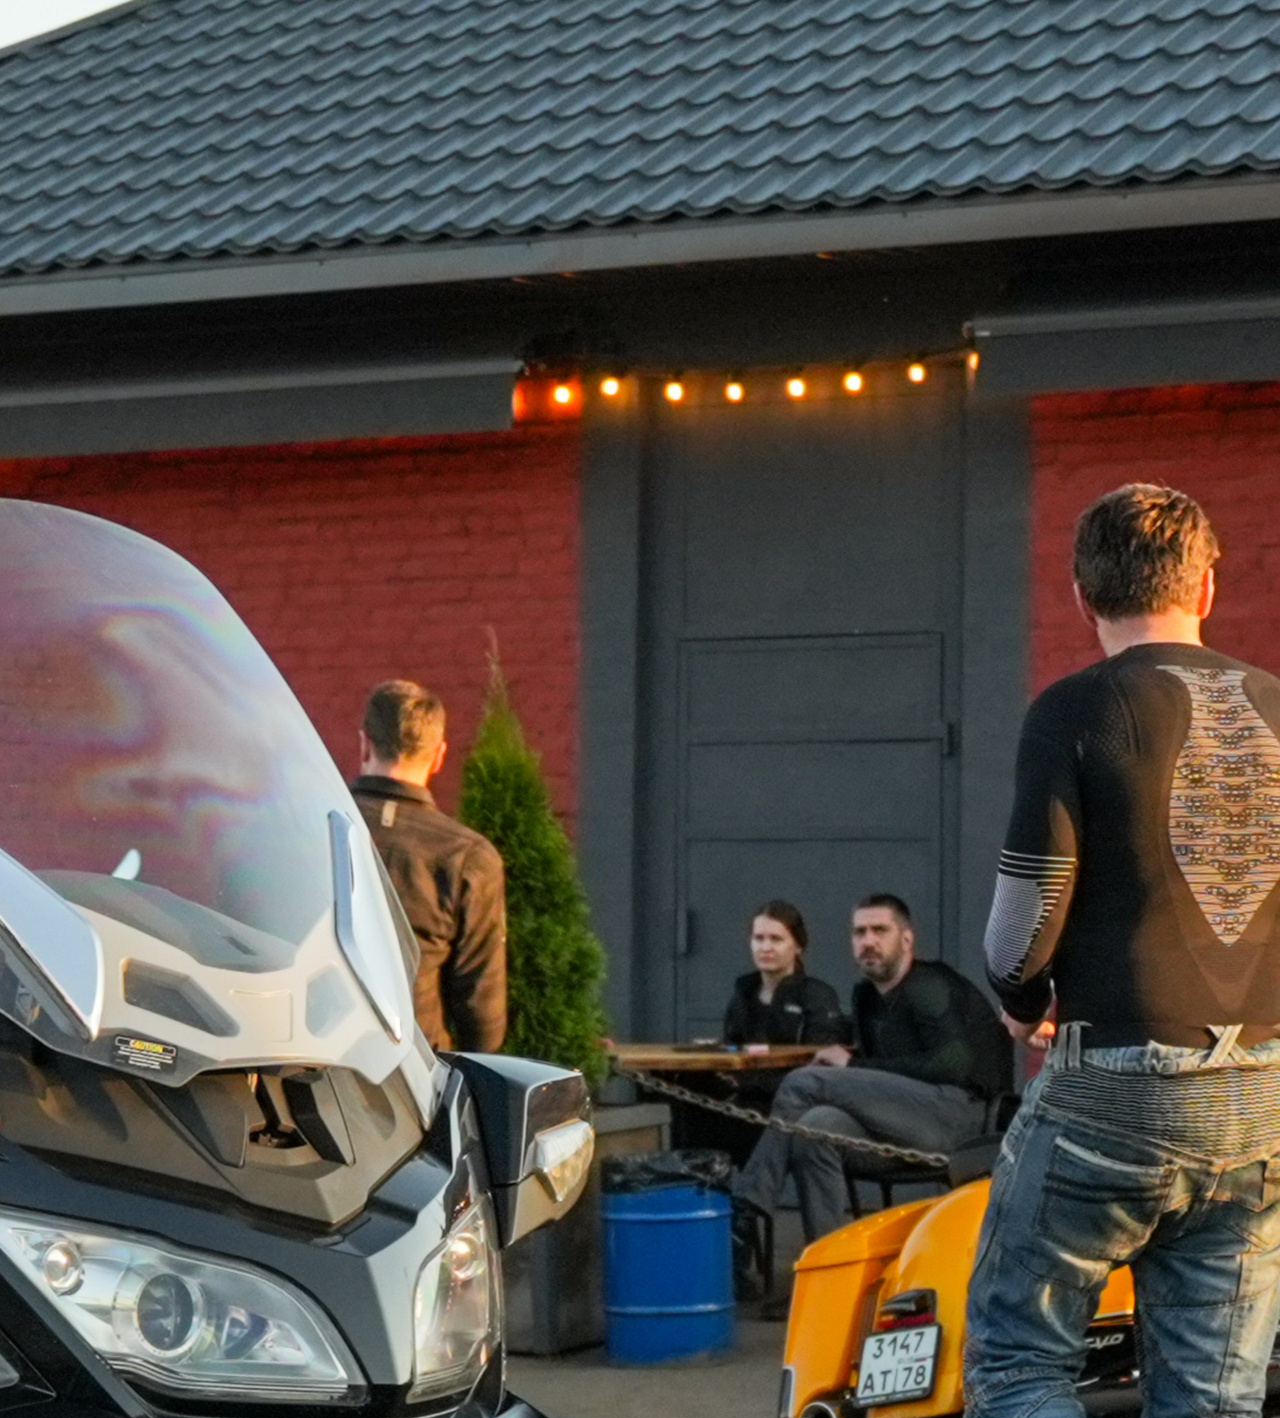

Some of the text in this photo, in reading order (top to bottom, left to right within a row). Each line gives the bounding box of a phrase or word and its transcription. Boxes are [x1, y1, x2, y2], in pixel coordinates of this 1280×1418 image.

[872, 1331, 925, 1359] 3147
[861, 1364, 926, 1395] AT 78
